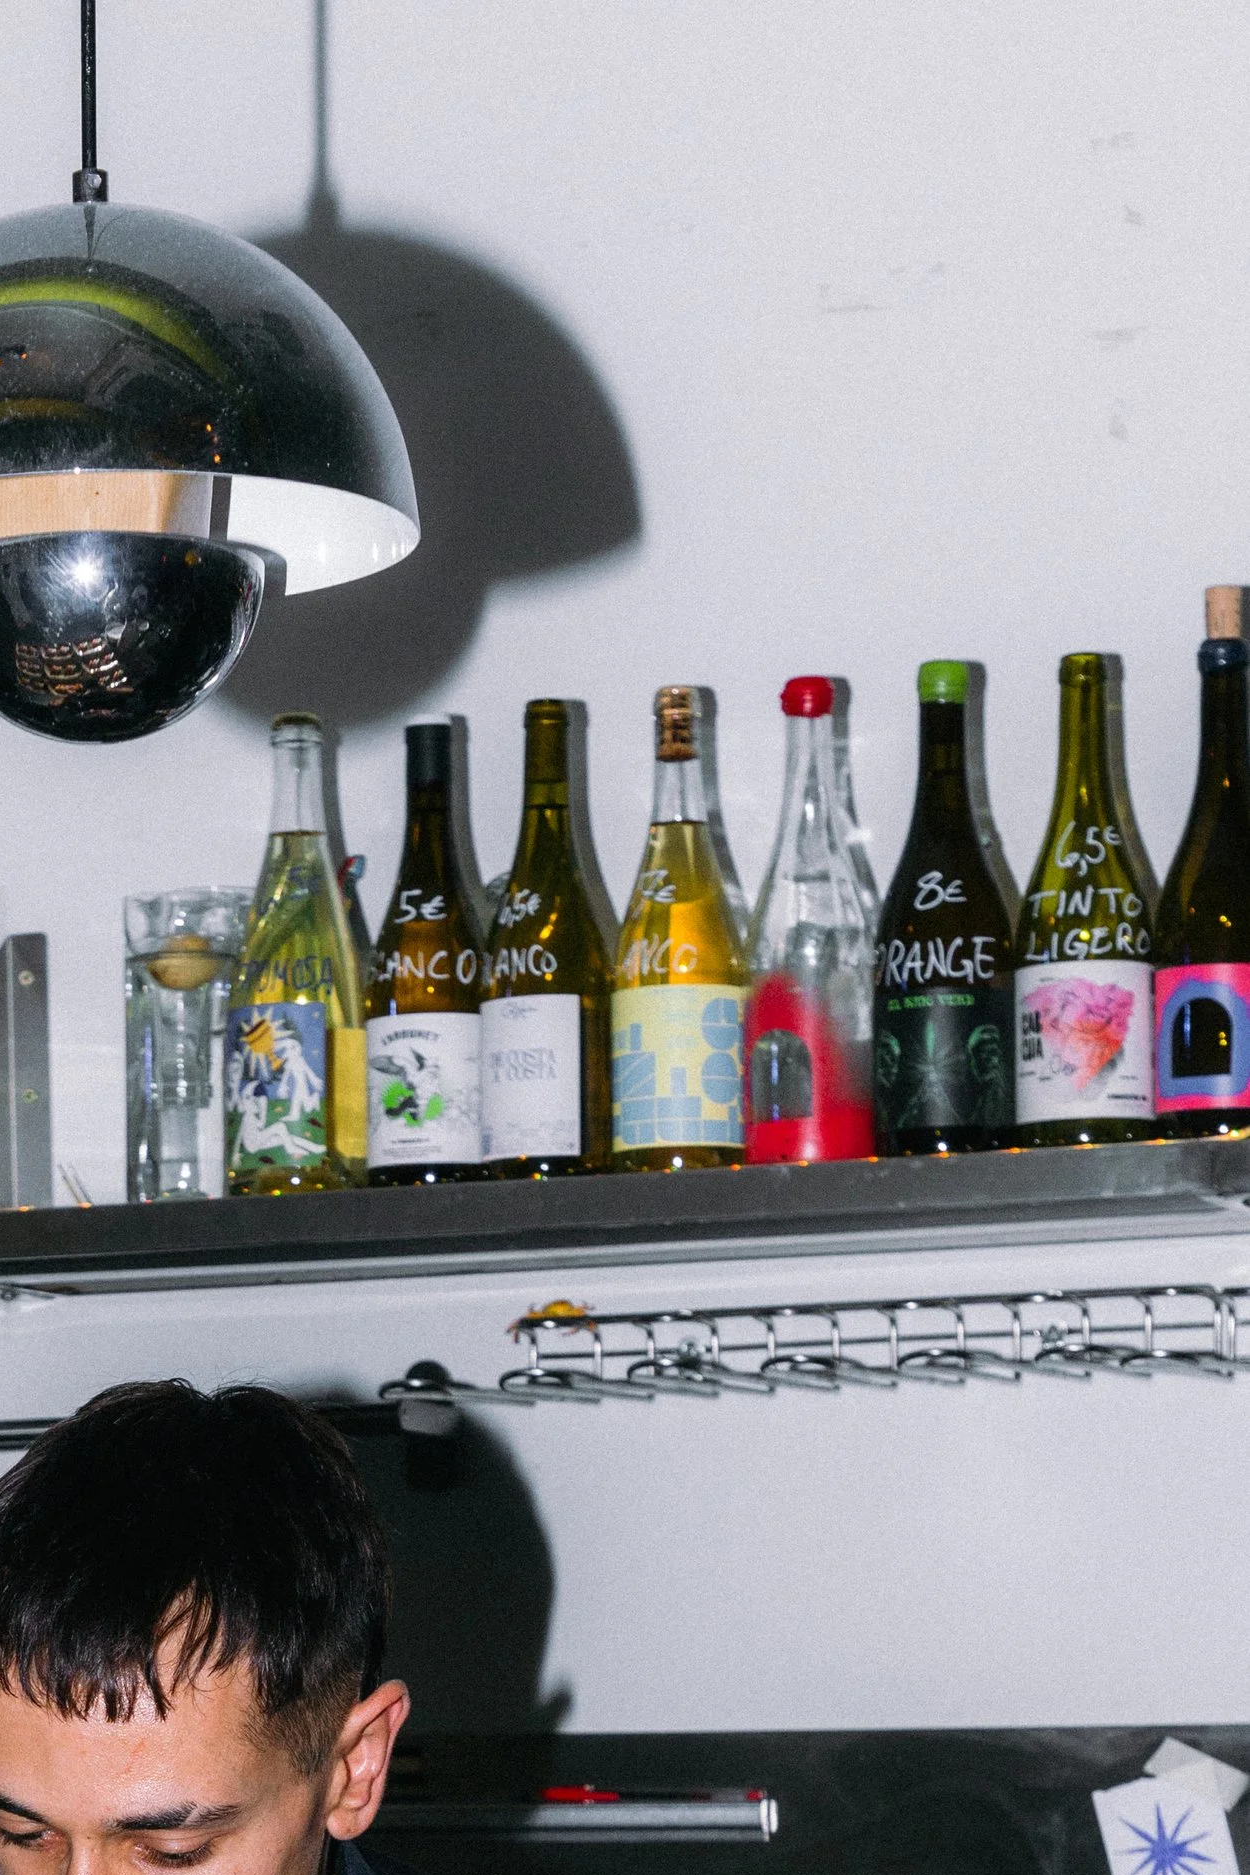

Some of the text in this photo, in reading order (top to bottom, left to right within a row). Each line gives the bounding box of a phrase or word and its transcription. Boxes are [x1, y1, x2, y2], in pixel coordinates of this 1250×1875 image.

[394, 889, 448, 924] 5€
[913, 870, 968, 912] 8€
[1028, 884, 1143, 918] TINTO
[1024, 921, 1150, 961] LIGERO
